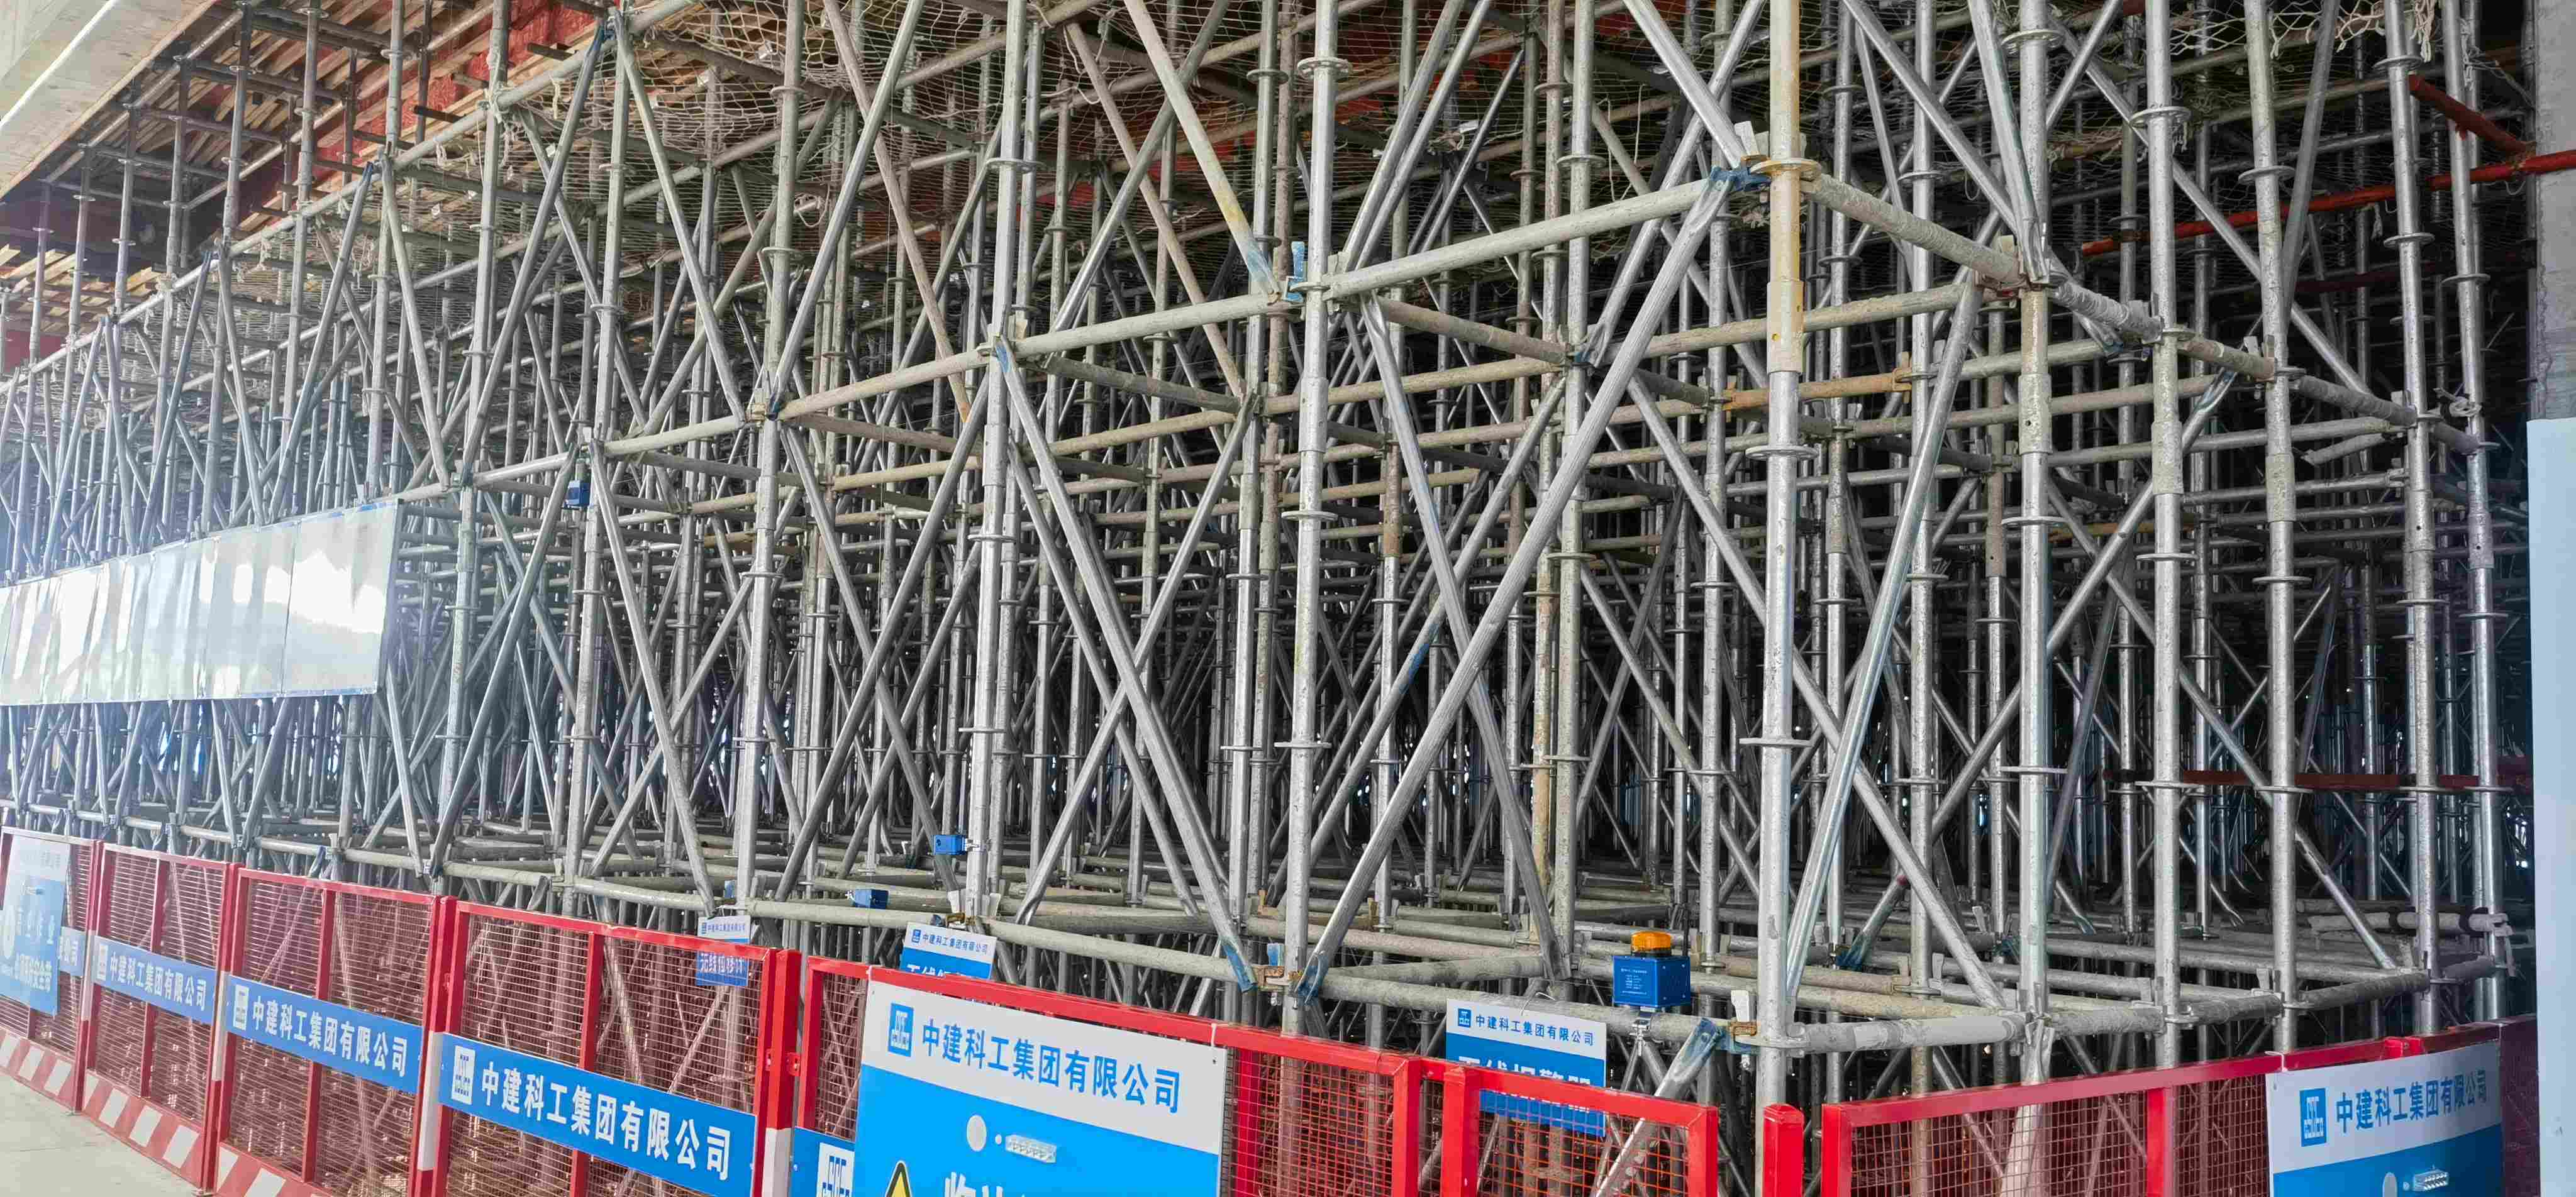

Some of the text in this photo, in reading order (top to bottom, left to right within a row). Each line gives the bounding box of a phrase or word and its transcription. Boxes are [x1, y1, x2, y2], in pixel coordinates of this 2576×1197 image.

[923, 934, 987, 954] 中建科工集团有限公司
[111, 951, 206, 1011] 中建科工集团有限公司
[253, 996, 408, 1077] 中建科工集团有限公司
[1475, 1015, 1594, 1046] 中建科工集团有限公司
[922, 1018, 1180, 1113] 中建科工集团有限公司
[482, 1061, 730, 1181] 中建科工集团有限公司
[2336, 1069, 2487, 1134] 中建科工集团有限公司
